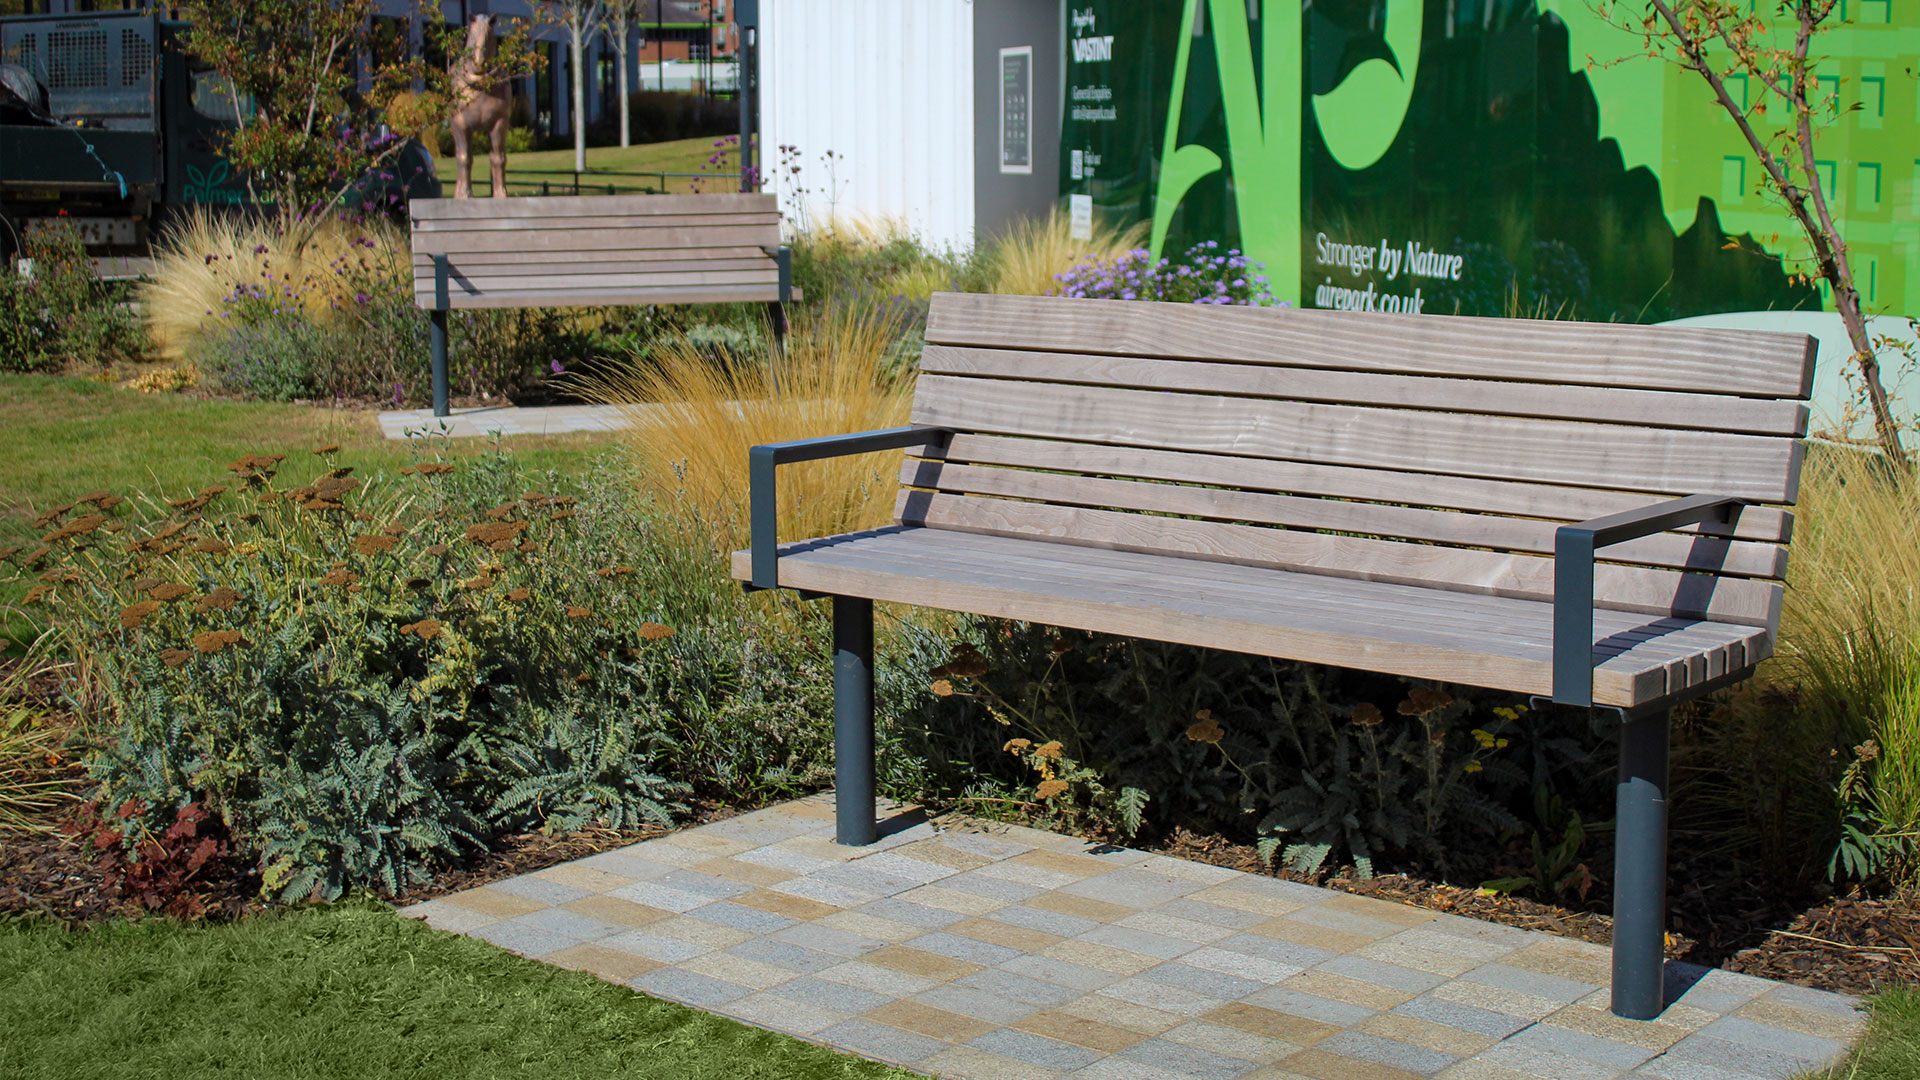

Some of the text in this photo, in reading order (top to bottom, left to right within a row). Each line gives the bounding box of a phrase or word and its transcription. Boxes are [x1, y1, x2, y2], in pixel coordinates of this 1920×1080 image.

[1072, 36, 1115, 63] VASTINT
[1316, 232, 1463, 280] Stronger by Nature
[1315, 276, 1425, 314] aireparkcouk
